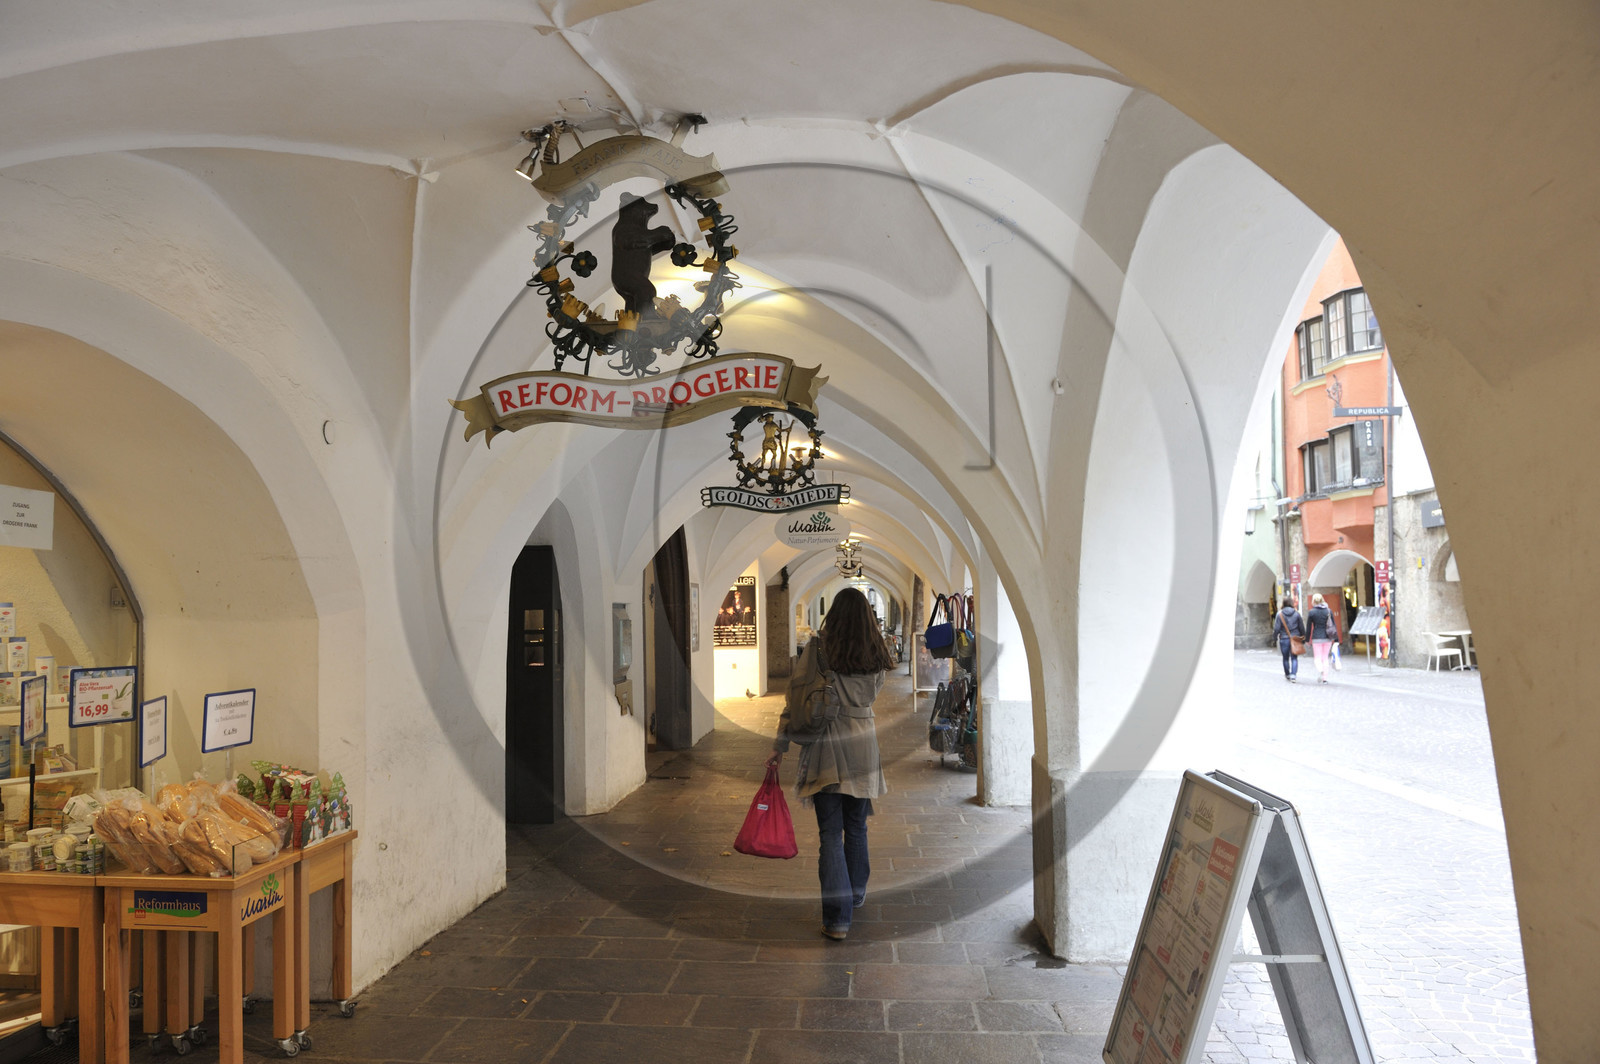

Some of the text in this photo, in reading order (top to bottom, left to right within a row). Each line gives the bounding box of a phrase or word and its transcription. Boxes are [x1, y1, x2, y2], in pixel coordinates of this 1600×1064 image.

[497, 365, 779, 414] REFORM-DROGERIE
[788, 520, 835, 533] Martin
[79, 704, 109, 718] 16,99
[138, 898, 201, 912] Reformhaus
[241, 888, 284, 921] Martin
